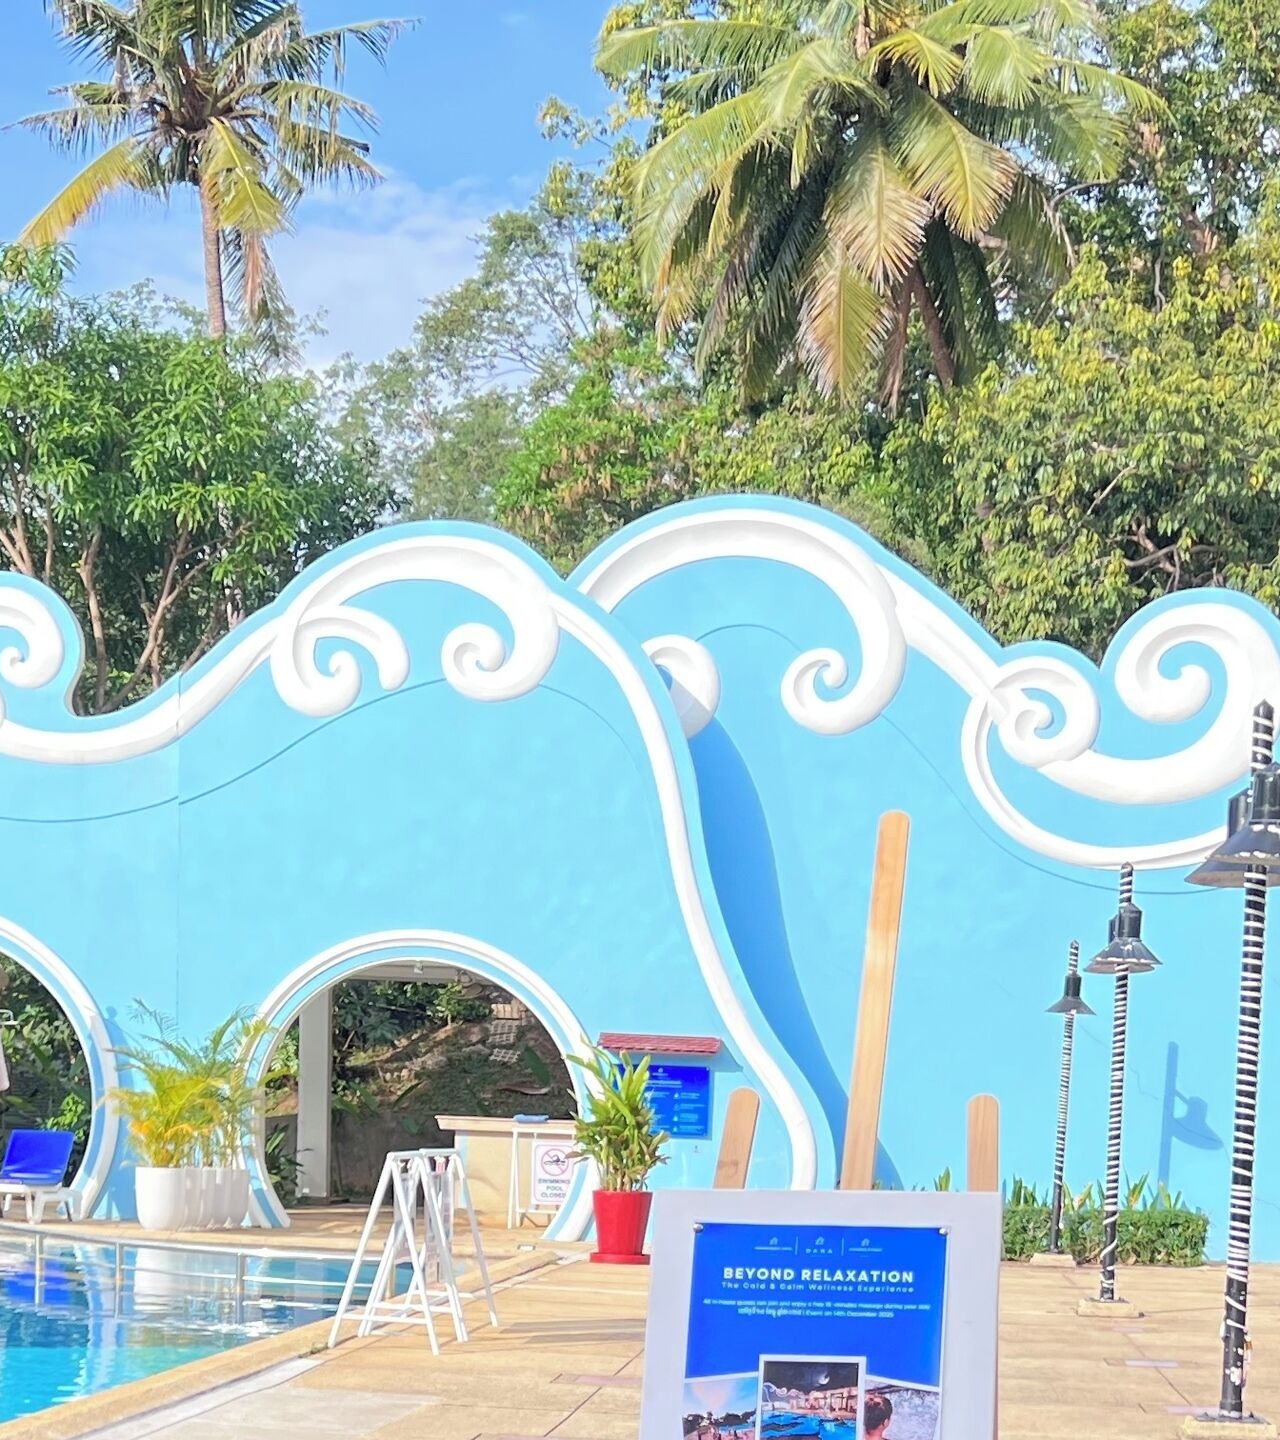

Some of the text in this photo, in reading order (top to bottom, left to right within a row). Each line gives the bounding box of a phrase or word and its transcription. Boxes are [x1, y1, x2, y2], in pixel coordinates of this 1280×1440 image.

[723, 1266, 914, 1284] BEYOND RELAXATION
[722, 1281, 739, 1289] The
[742, 1282, 767, 1290] Cold
[779, 1283, 805, 1291] Calm
[808, 1283, 854, 1292] Wellness
[857, 1285, 915, 1294] Experience
